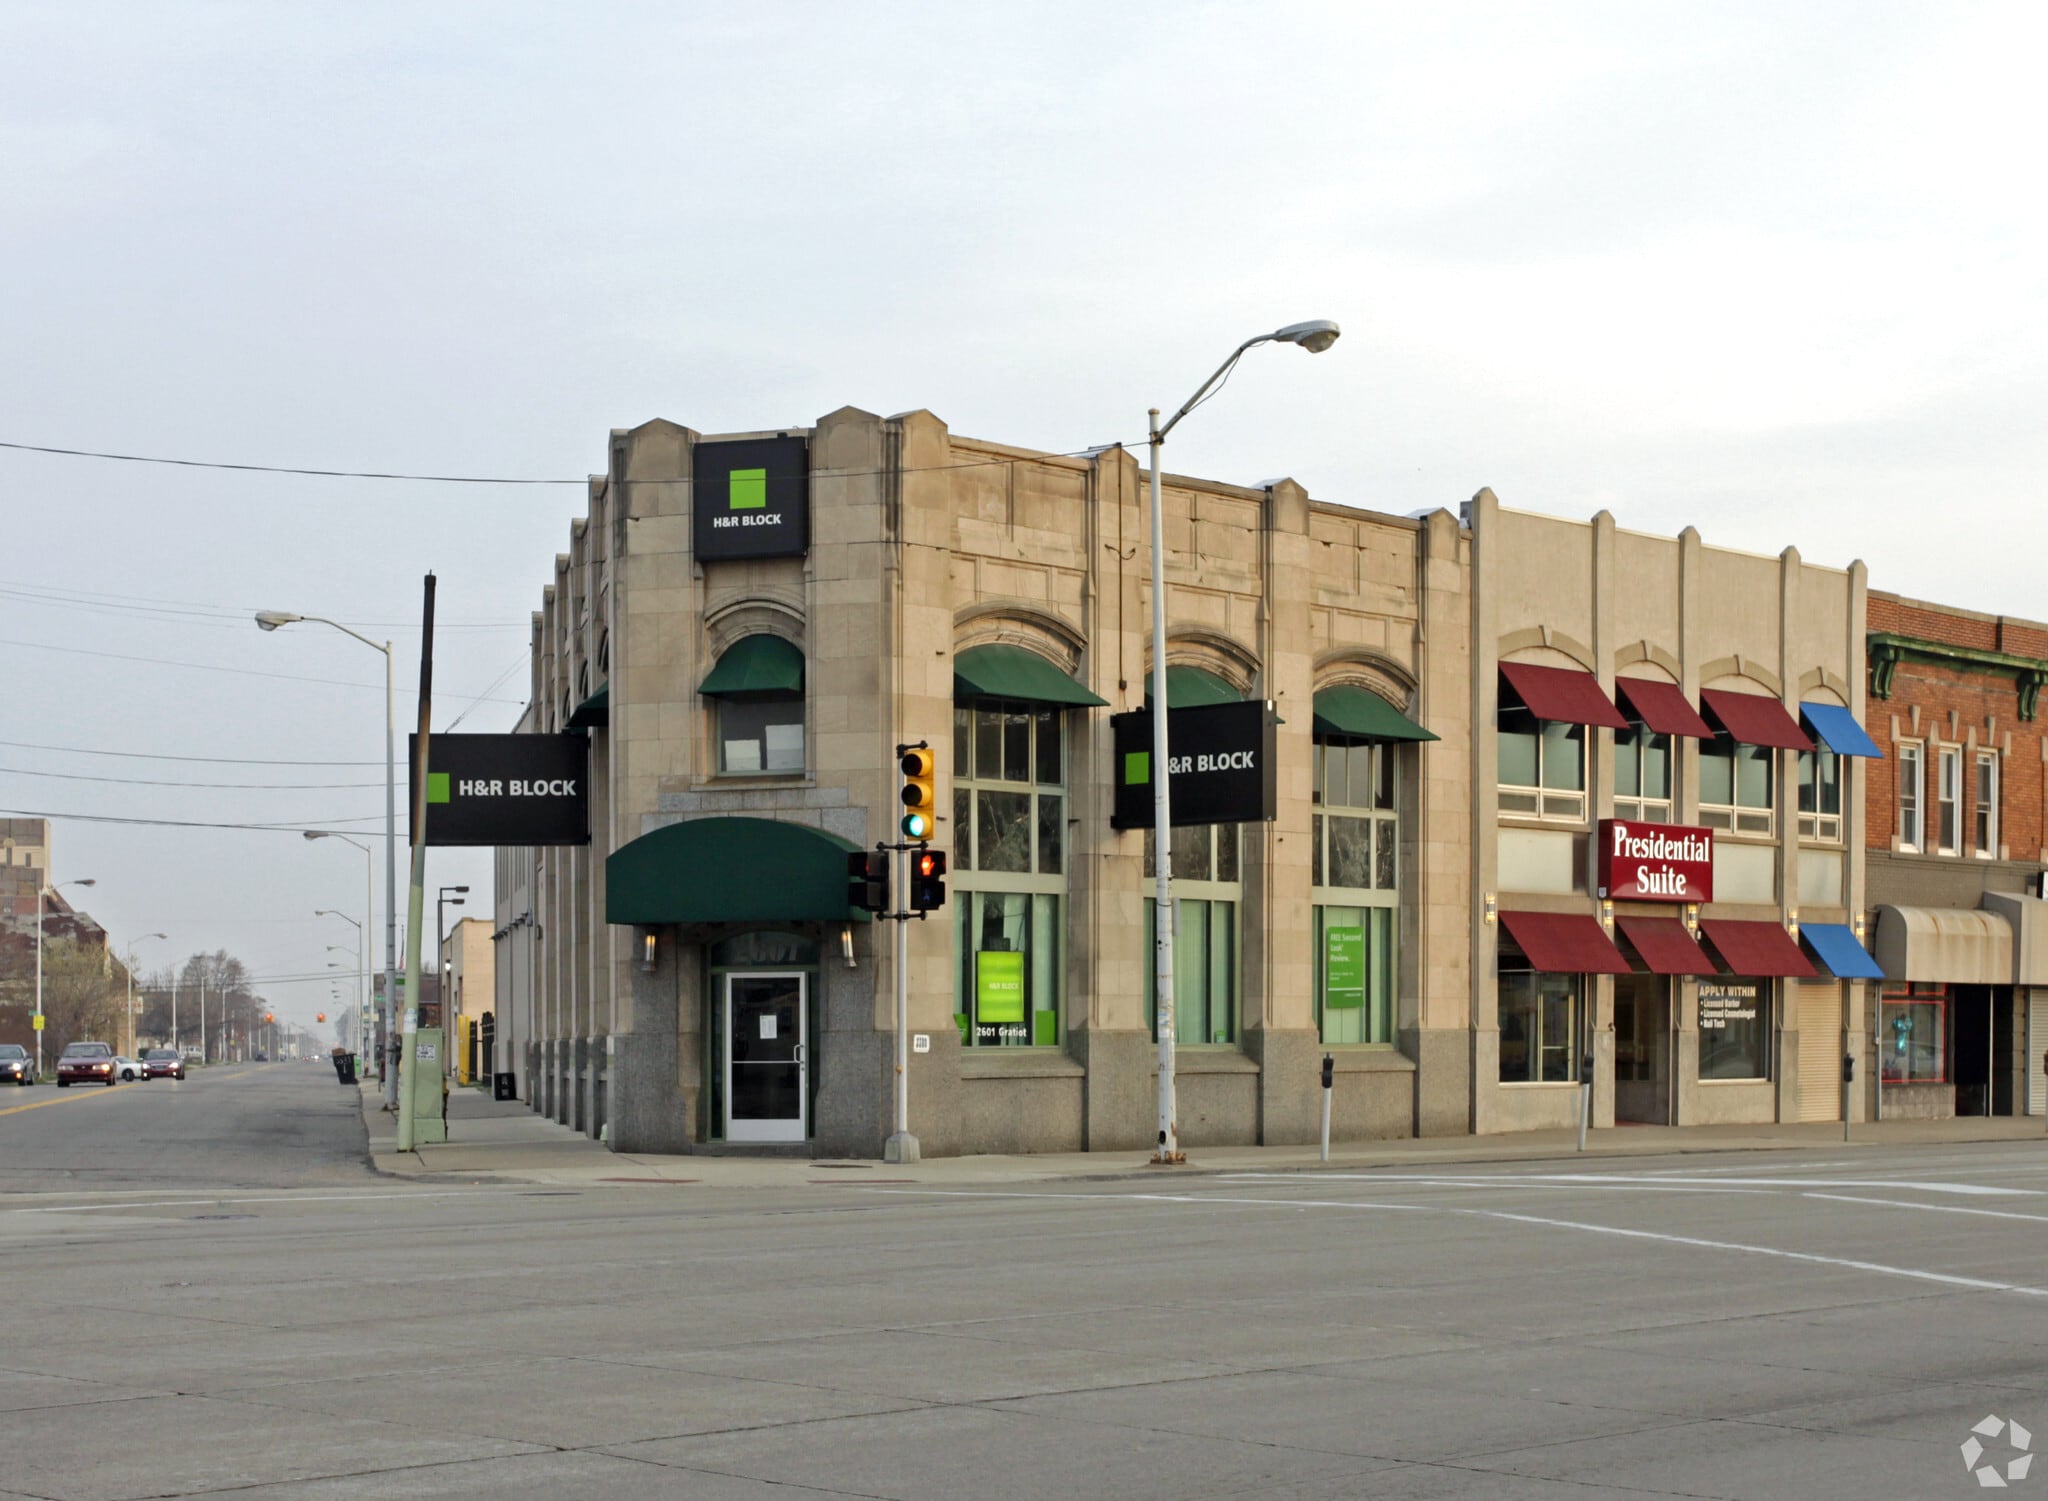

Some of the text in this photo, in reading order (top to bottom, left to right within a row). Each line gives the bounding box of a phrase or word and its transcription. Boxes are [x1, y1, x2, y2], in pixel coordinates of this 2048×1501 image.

[713, 513, 782, 528] H&R BLOCK
[1197, 751, 1255, 772] BLOCK
[459, 779, 577, 796] H&R BLOCK
[1613, 825, 1710, 862] Presidential
[1636, 864, 1687, 895] Suite
[1001, 982, 1019, 990] BLOCK
[1699, 986, 1756, 997] APPLY WITHIN
[976, 1027, 1027, 1037] 2601 Gratiot
